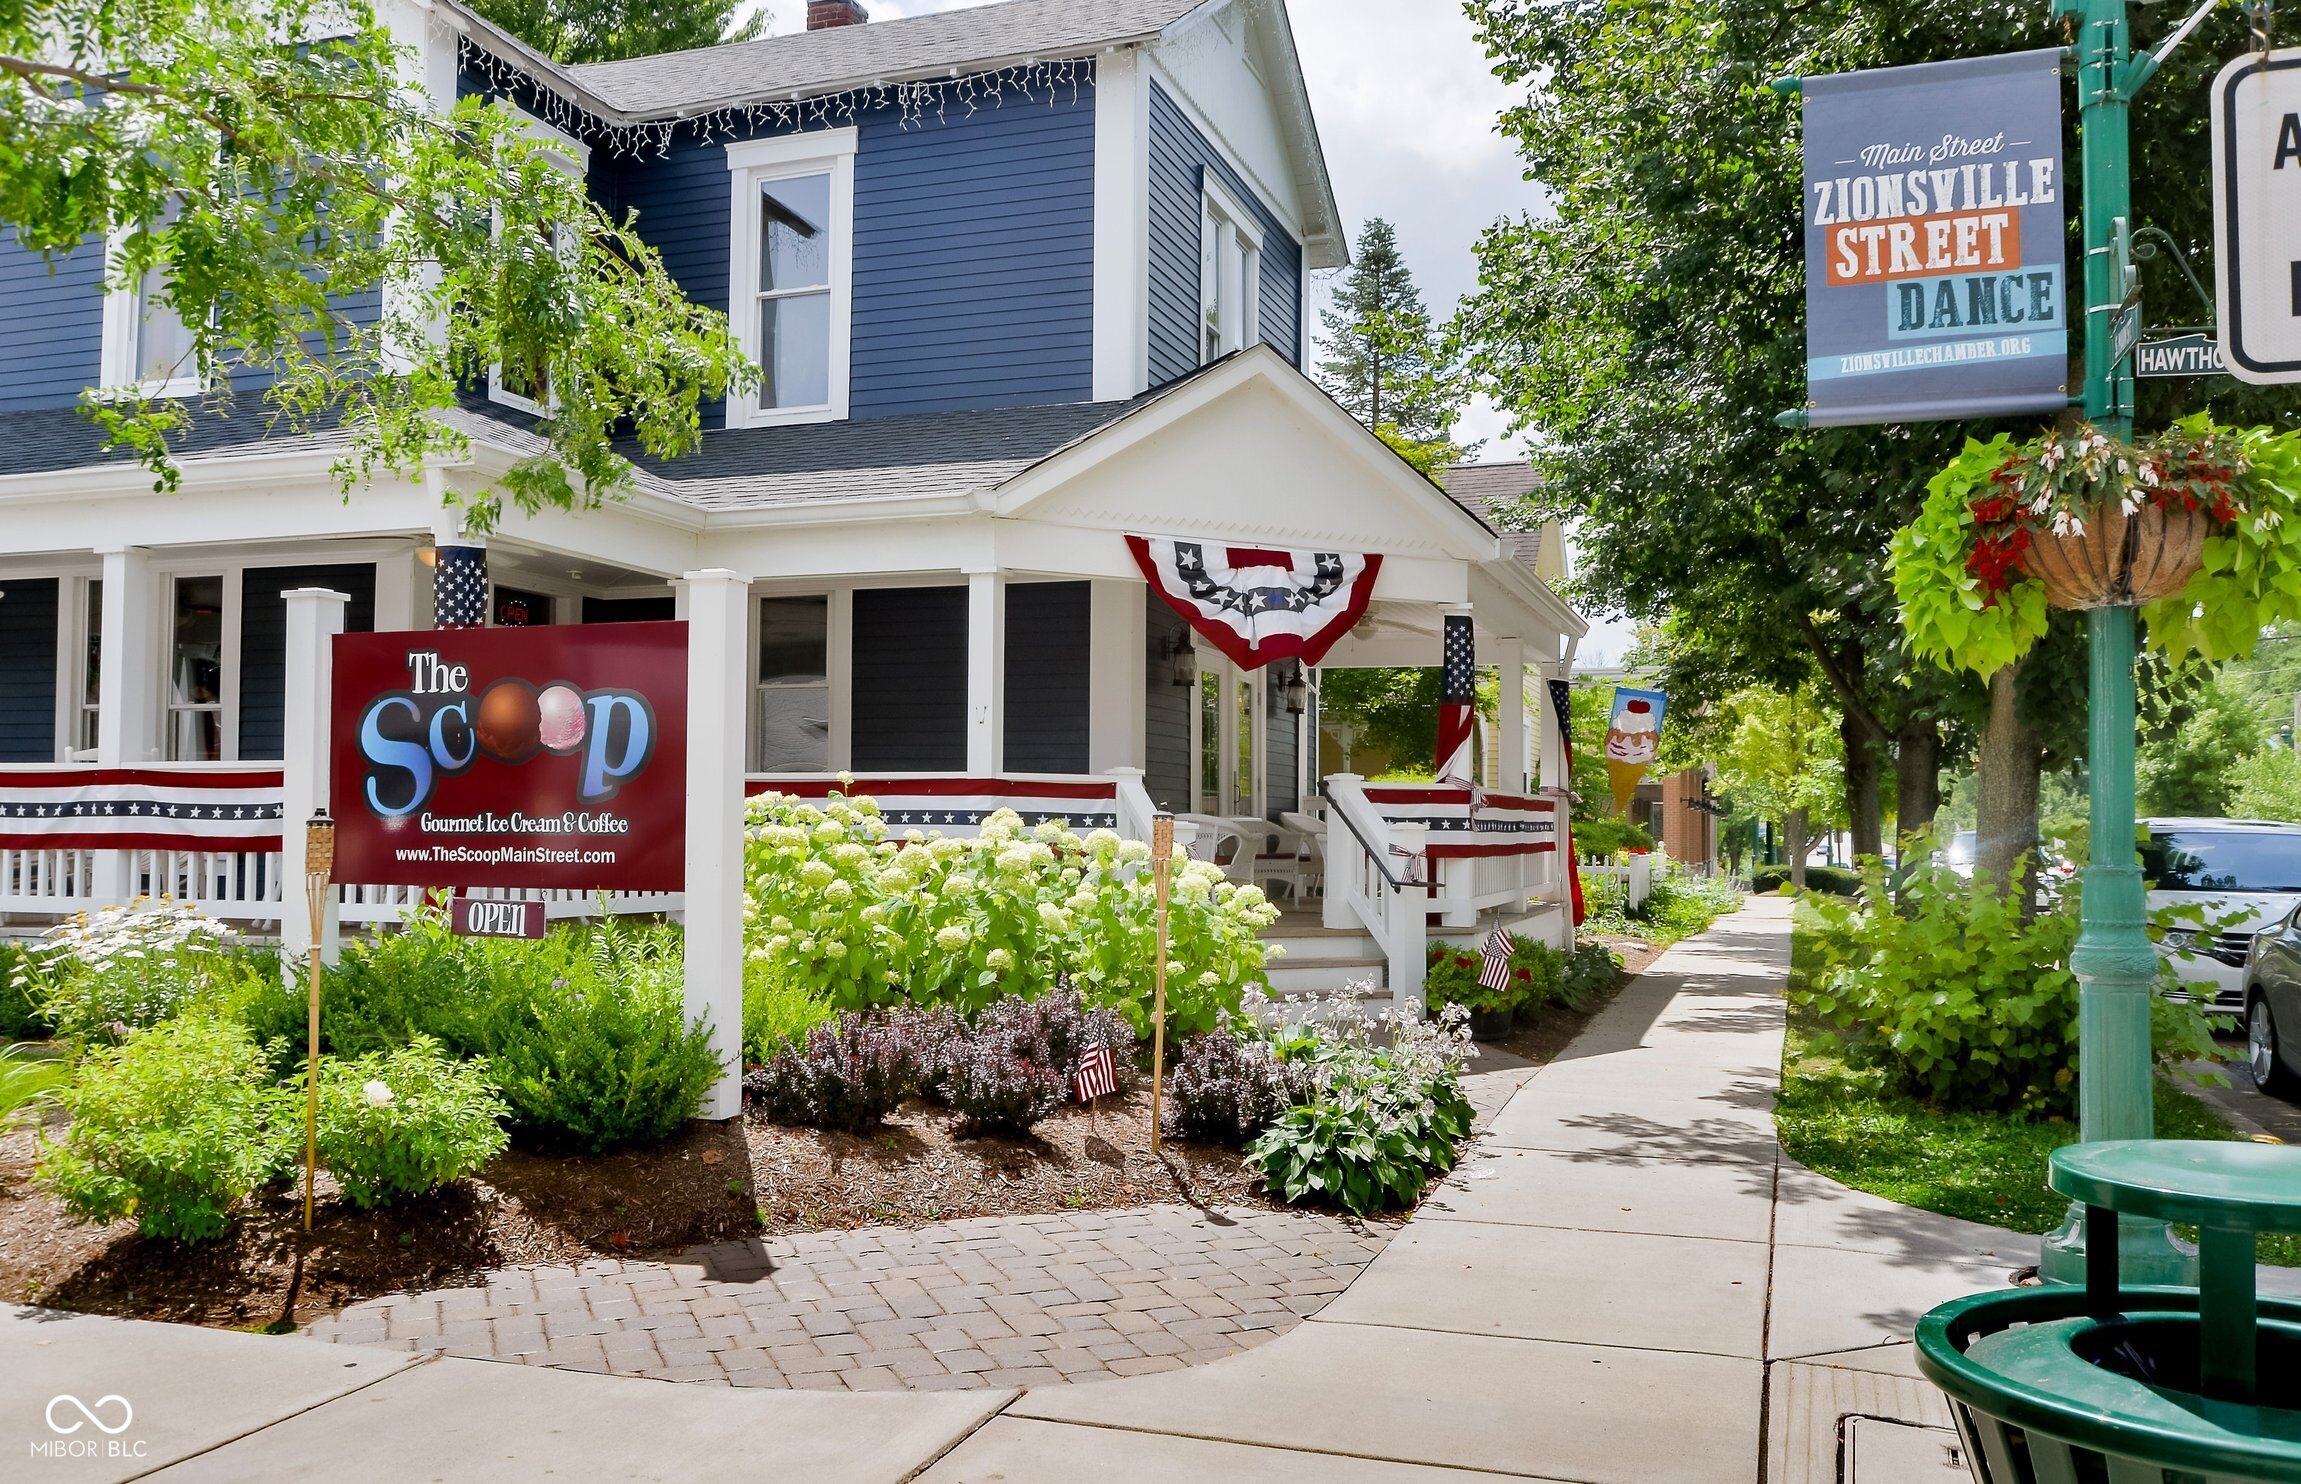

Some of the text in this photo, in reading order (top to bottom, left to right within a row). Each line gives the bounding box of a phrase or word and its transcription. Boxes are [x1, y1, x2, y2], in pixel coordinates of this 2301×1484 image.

[1860, 131, 2005, 170] Main Street
[1813, 157, 2056, 226] ZIONSVILLE
[1835, 213, 2009, 278] STREET
[1896, 271, 2054, 332] DANCE
[1840, 336, 2031, 374] ZIONSVILLECHAMBER.ORG
[408, 651, 468, 694] The
[360, 682, 650, 816] Scoop
[420, 811, 629, 833] Gourmet Ice Cream & Coffee
[396, 846, 616, 865] www.TheScoopMainStreet.com
